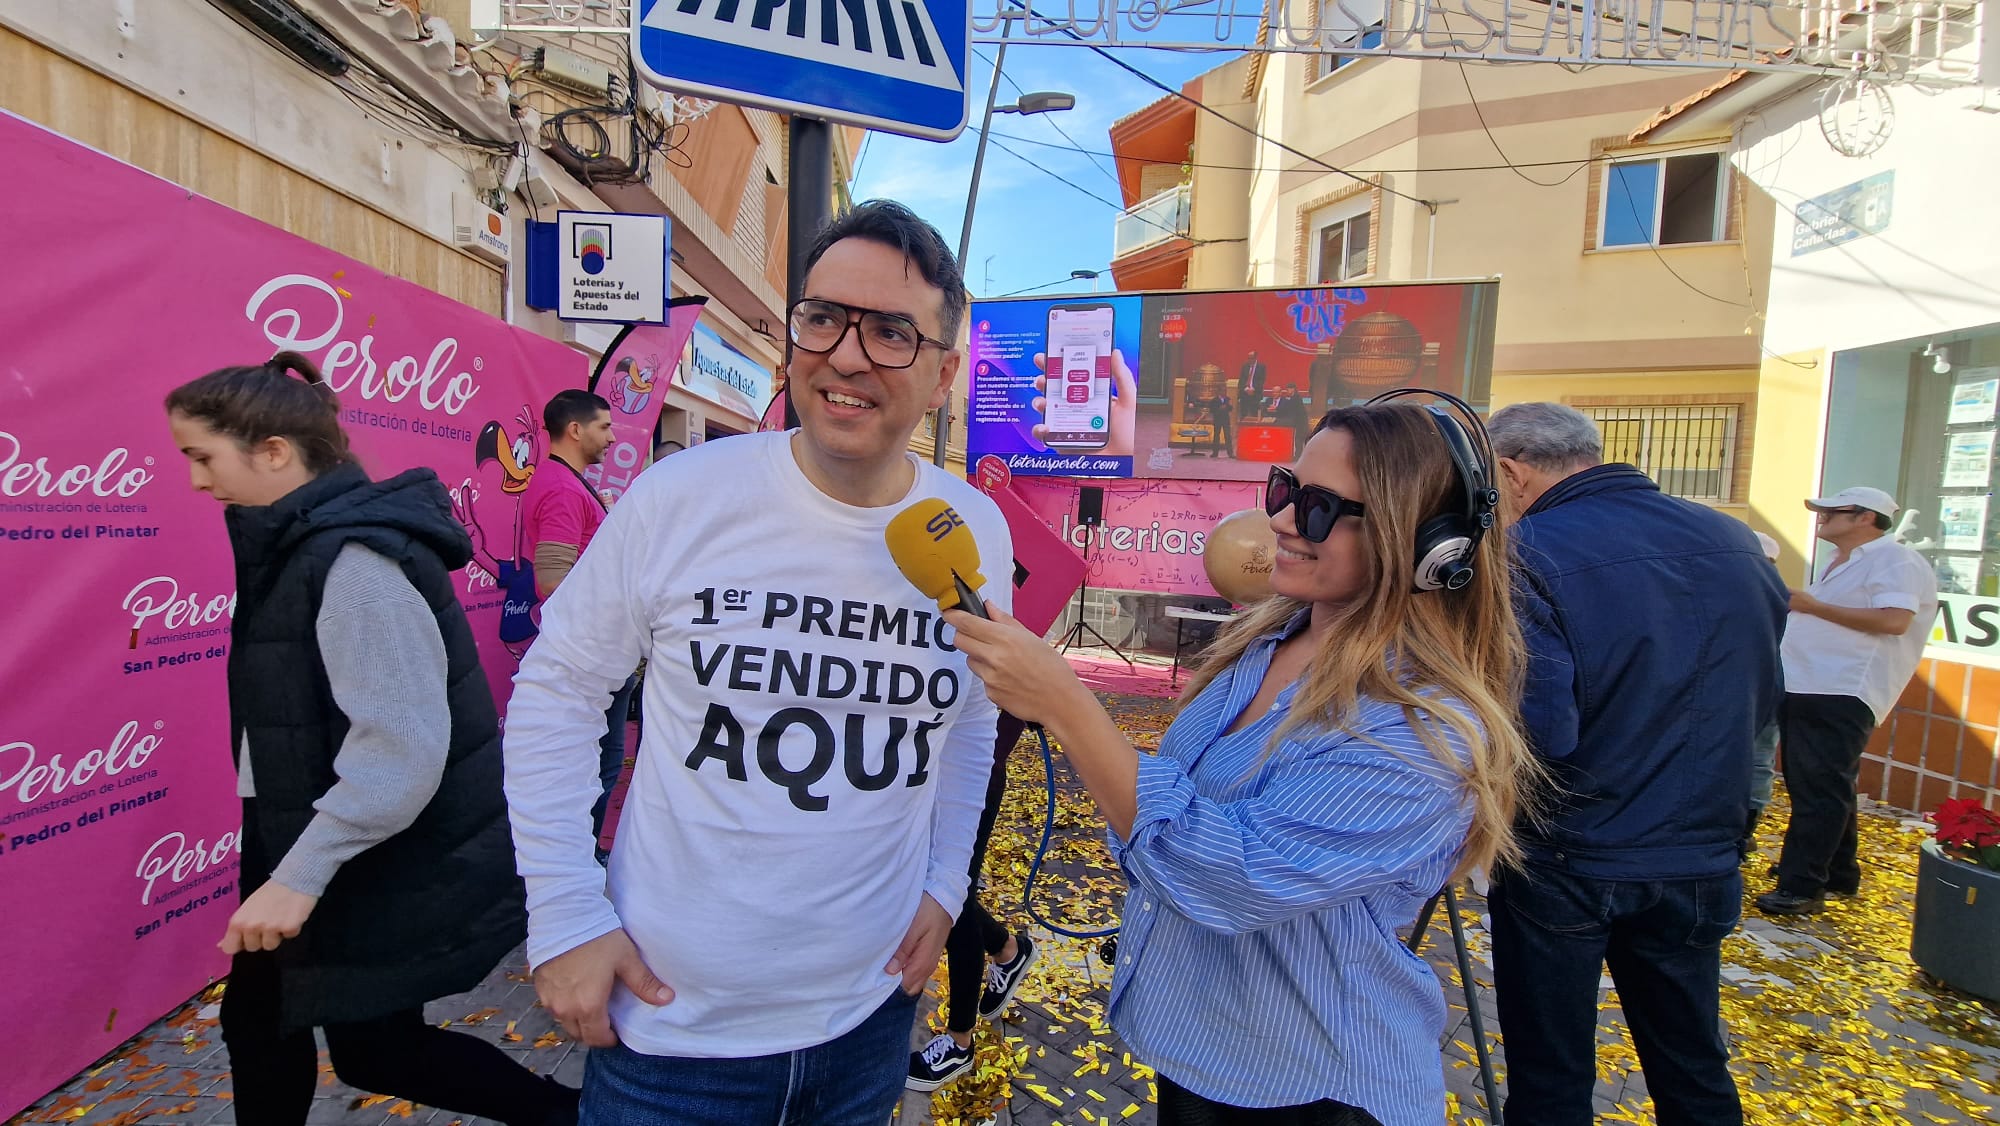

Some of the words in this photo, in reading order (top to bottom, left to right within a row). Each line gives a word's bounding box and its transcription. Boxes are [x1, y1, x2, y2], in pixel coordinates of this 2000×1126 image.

[479, 229, 509, 255] Amstrong
[618, 281, 624, 290] y
[574, 289, 621, 301] Apuestas
[624, 290, 640, 301] del
[573, 301, 609, 311] Estado
[411, 417, 427, 434] de
[1008, 453, 1121, 473] loteriasperolo.com
[86, 502, 102, 513] de
[62, 524, 89, 539] del
[95, 524, 160, 538] Pinatar
[1061, 514, 1206, 556] loterias
[1240, 561, 1273, 575] Perol
[123, 660, 153, 675] San
[158, 651, 202, 668] Pedro
[205, 645, 226, 659] del
[689, 640, 959, 709] VENDIDO
[684, 702, 945, 812] AQUÍ
[99, 782, 114, 795] de
[11, 822, 71, 851] Pedro
[77, 807, 104, 828] del
[110, 786, 169, 816] Pinatar
[135, 919, 161, 940] San
[165, 895, 209, 924] Pedro
[212, 880, 234, 899] del
